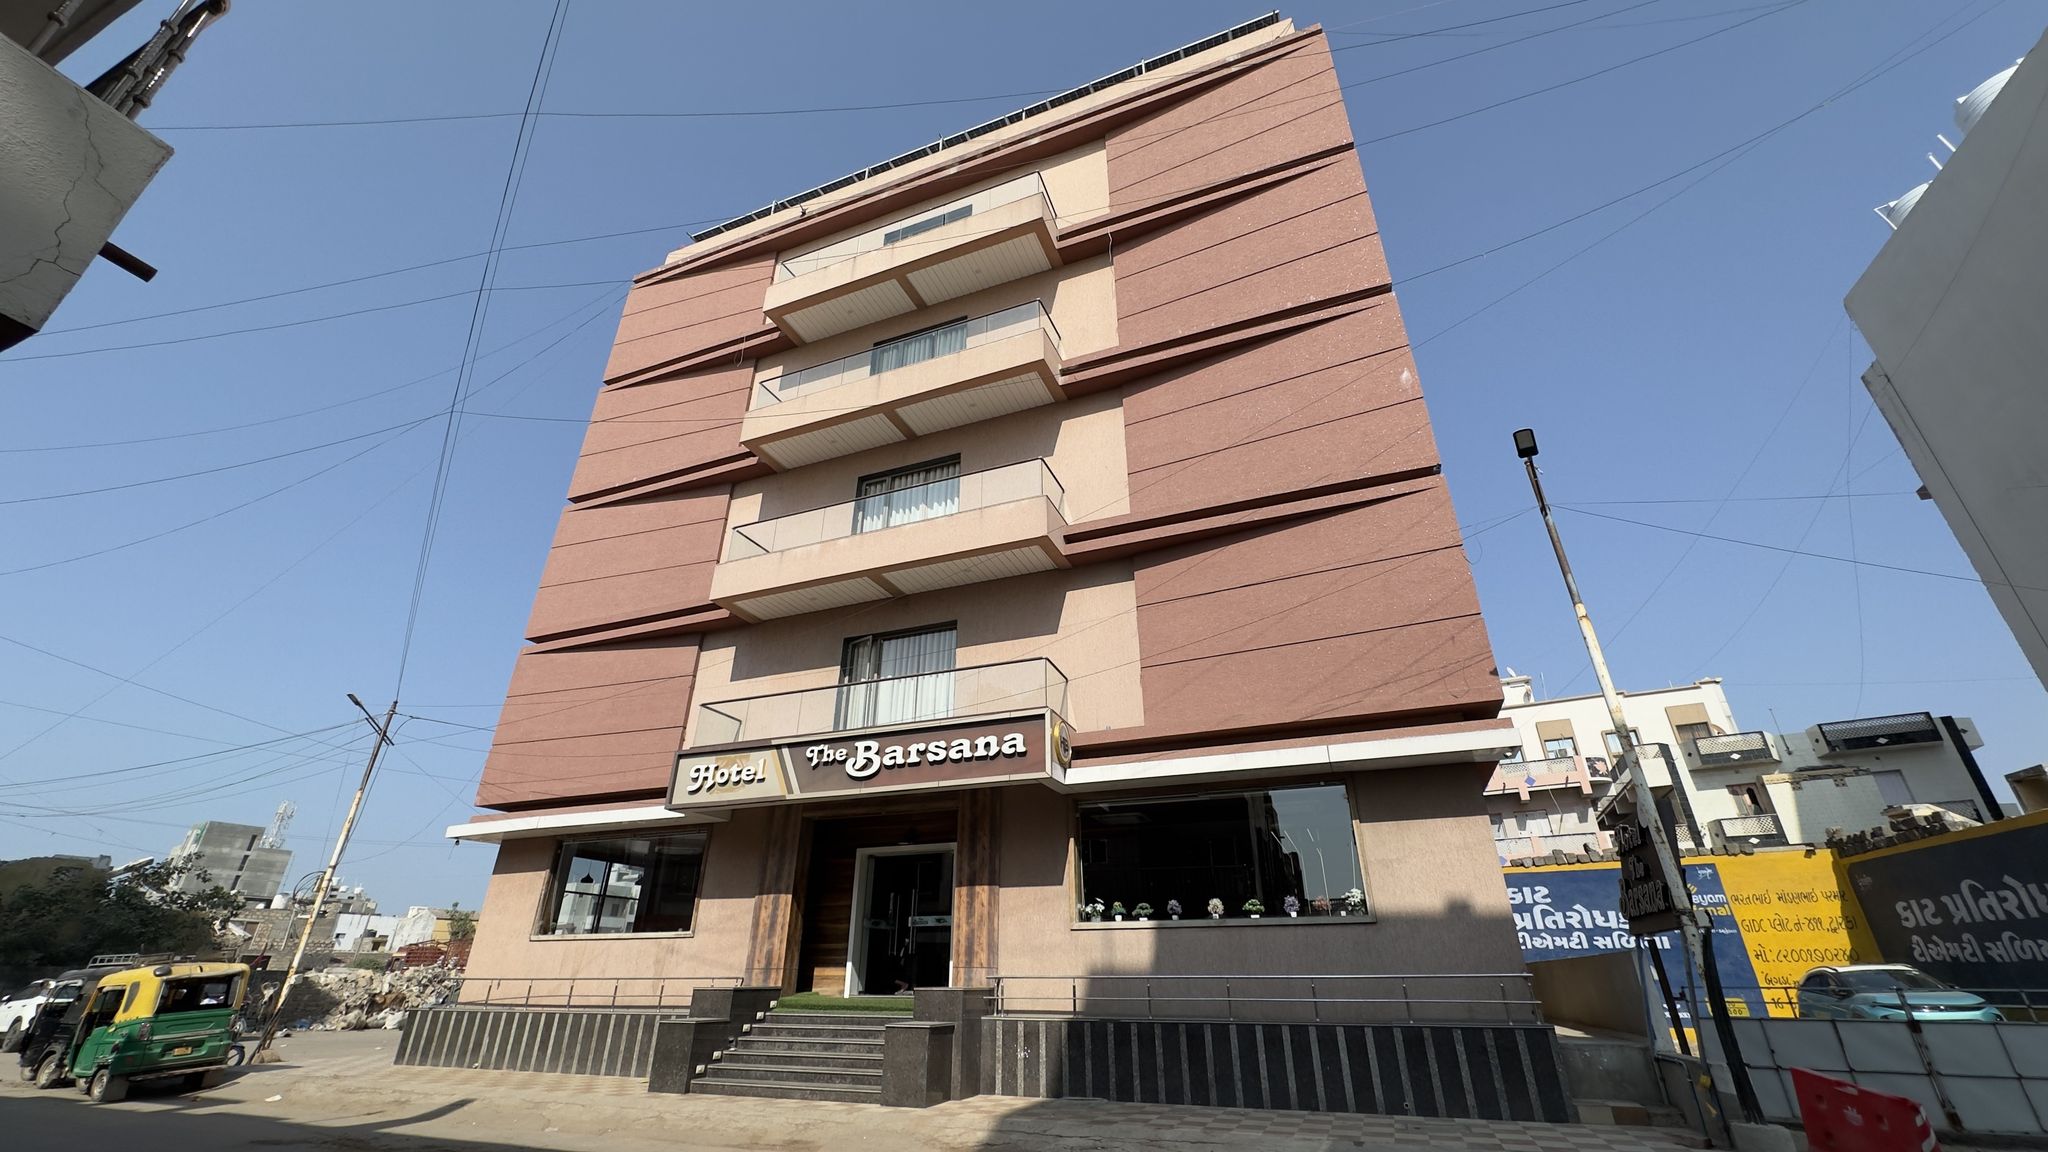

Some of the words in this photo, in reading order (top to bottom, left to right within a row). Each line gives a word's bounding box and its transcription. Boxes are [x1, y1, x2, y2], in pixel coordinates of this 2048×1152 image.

[688, 758, 766, 794] Hotel
[805, 744, 847, 768] The
[845, 731, 1027, 780] Barsana
[1618, 879, 1666, 919] Barsana
[1895, 898, 1943, 928] કાટ
[1740, 919, 1767, 933] GIDC
